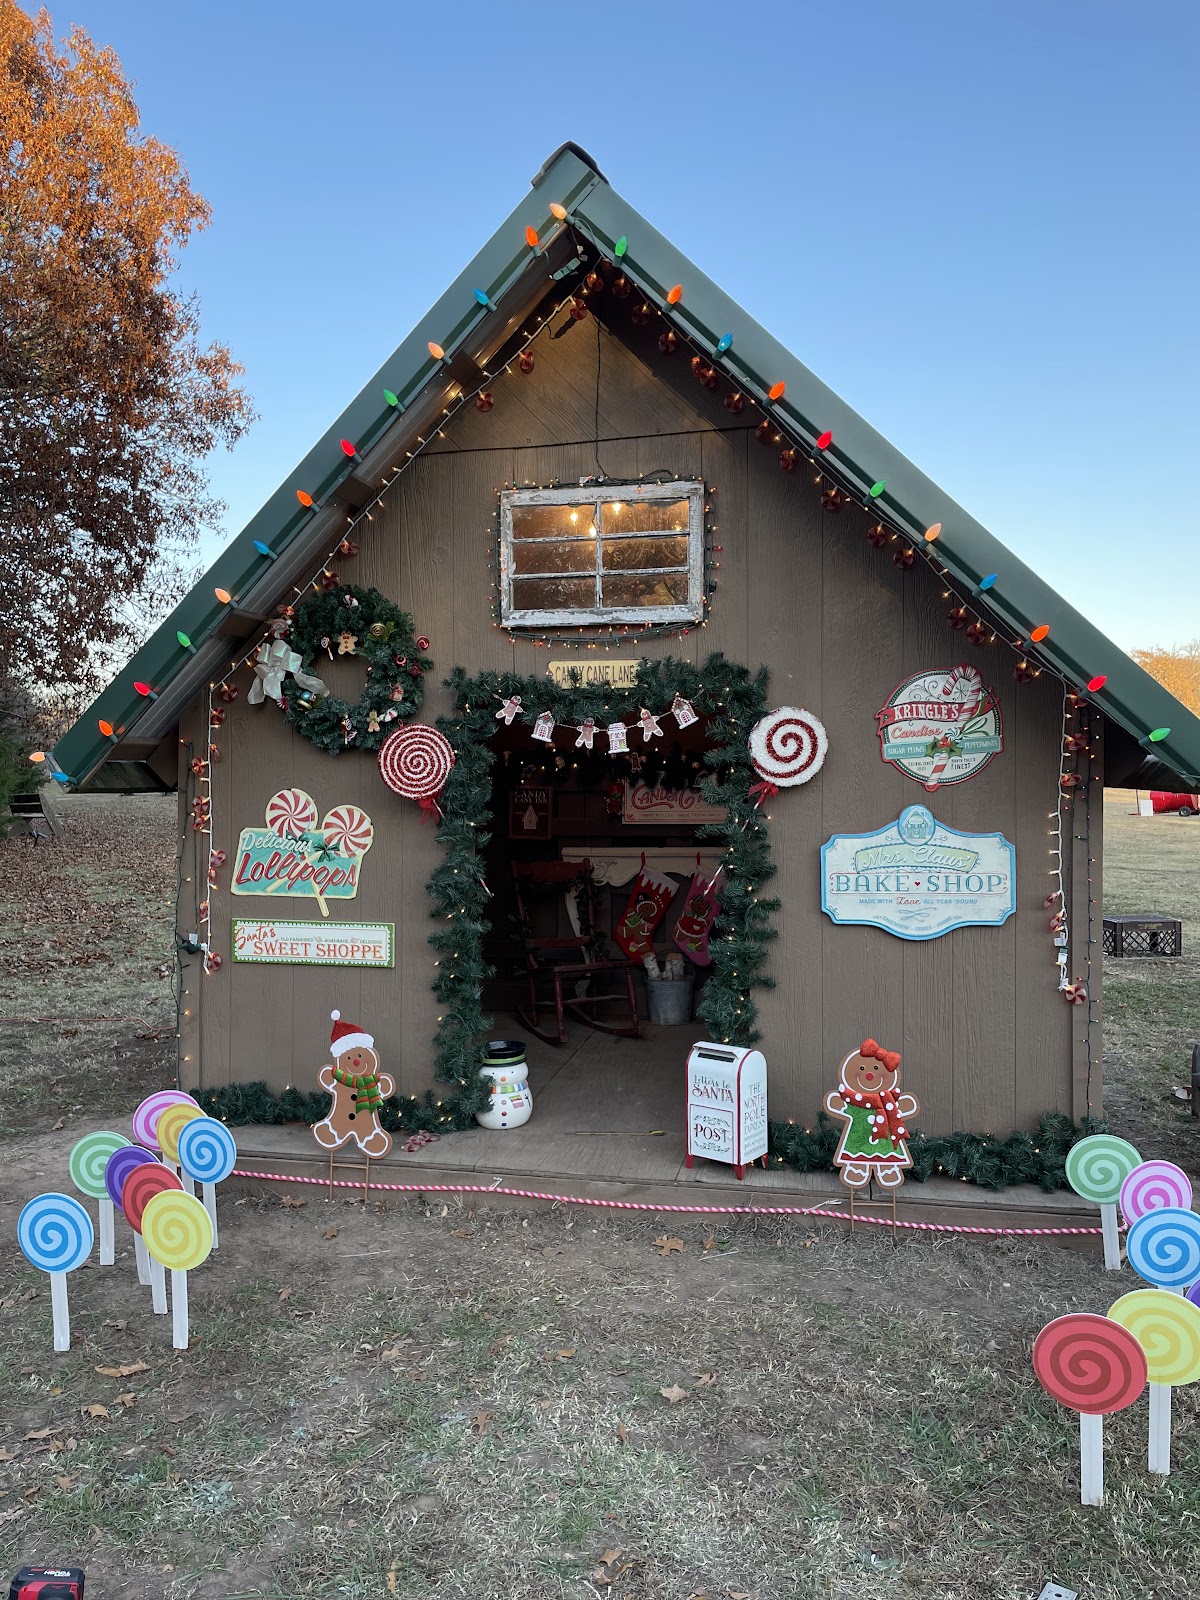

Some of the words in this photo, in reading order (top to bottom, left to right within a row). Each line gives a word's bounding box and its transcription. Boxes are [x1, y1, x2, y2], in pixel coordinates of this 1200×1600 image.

[586, 665, 610, 683] CANE
[612, 665, 635, 683] LANE
[893, 703, 959, 721] KRINGLE'S
[891, 725, 943, 739] Candies
[887, 747, 906, 755] SUGAR
[907, 745, 925, 753] PLUMS
[514, 789, 548, 798] CANDY
[241, 832, 312, 853] Delicious
[862, 847, 907, 868] Mrs.
[235, 851, 357, 896] Lollypops
[835, 874, 910, 892] BAKE
[926, 874, 1003, 892] SHOP
[896, 896, 921, 906] Love
[234, 922, 277, 950] Santa's
[253, 940, 312, 956] SWEET
[315, 943, 384, 960] SHOPPE
[693, 1074, 719, 1087] Letters
[748, 1081, 762, 1096] THE
[691, 1083, 734, 1103] SANTA
[744, 1092, 766, 1109] NORTH
[744, 1105, 765, 1124] POLE
[693, 1122, 730, 1143] POST
